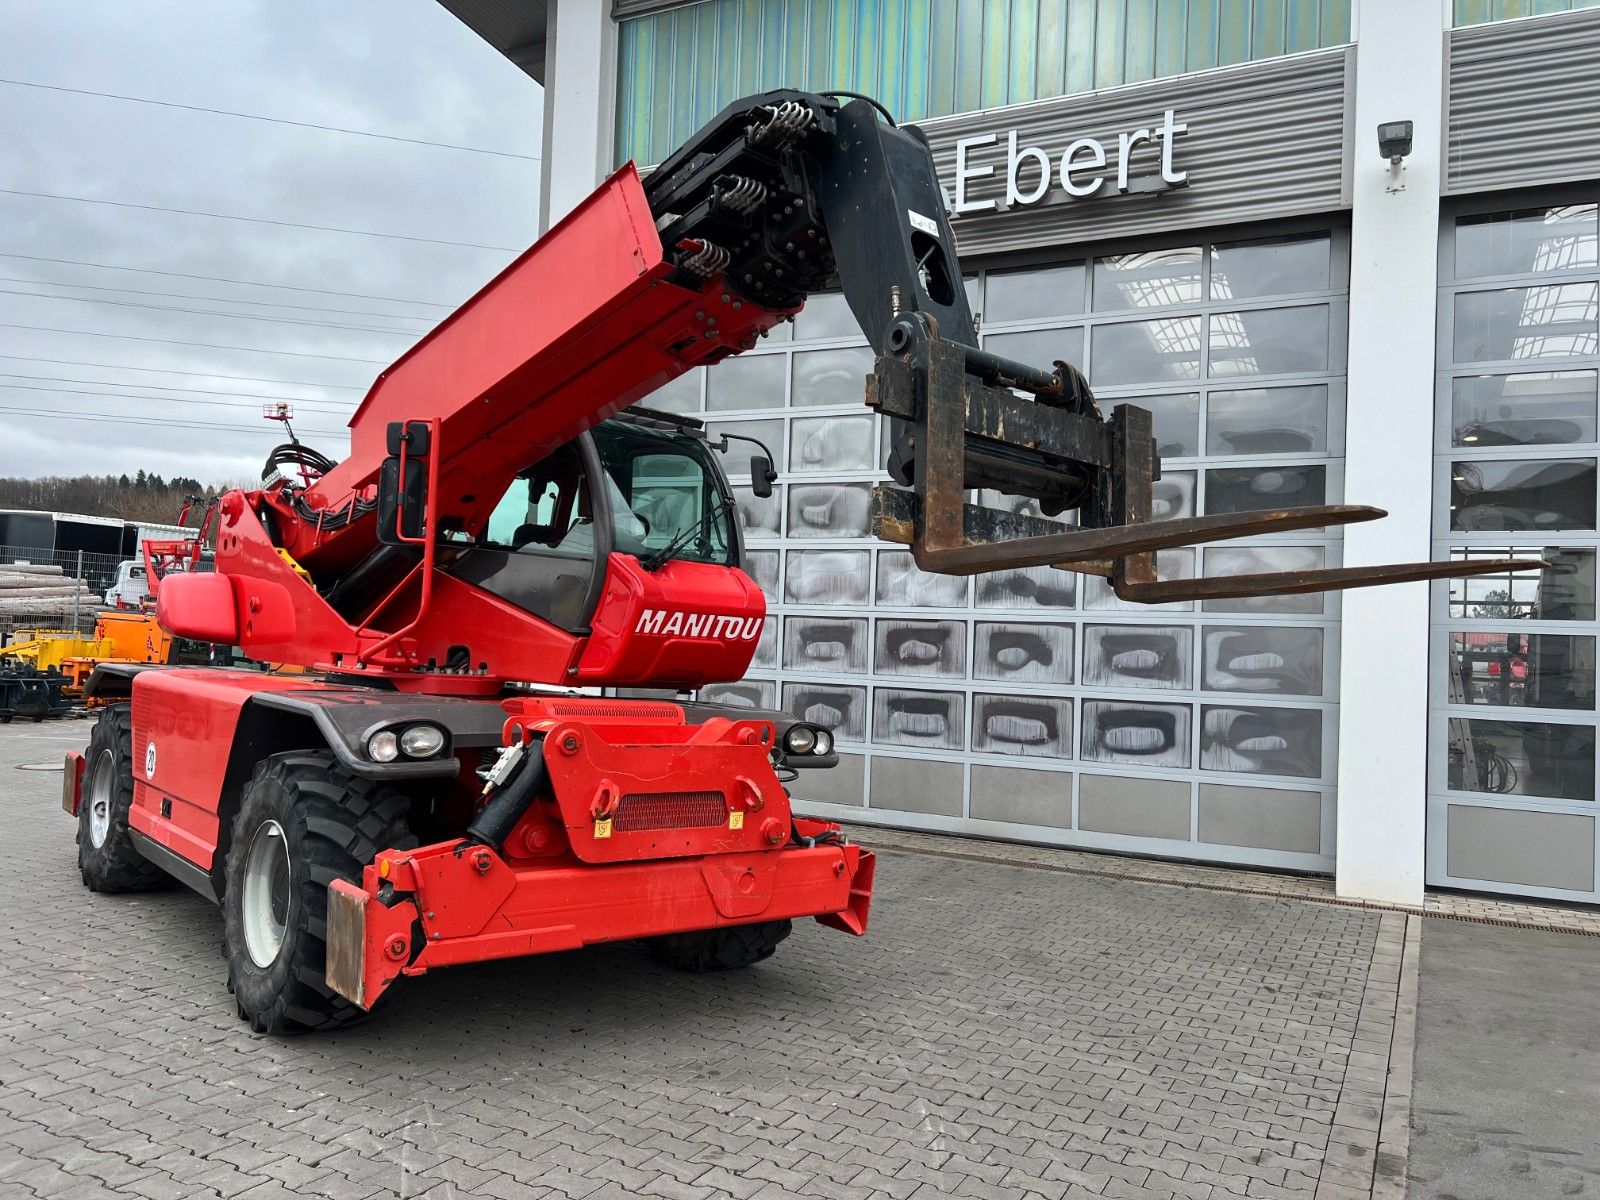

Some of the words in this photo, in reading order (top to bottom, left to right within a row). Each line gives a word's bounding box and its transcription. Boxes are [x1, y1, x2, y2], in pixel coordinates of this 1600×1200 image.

[955, 109, 1188, 214] Ebert
[634, 609, 762, 640] MANITOU
[147, 749, 154, 772] 20
